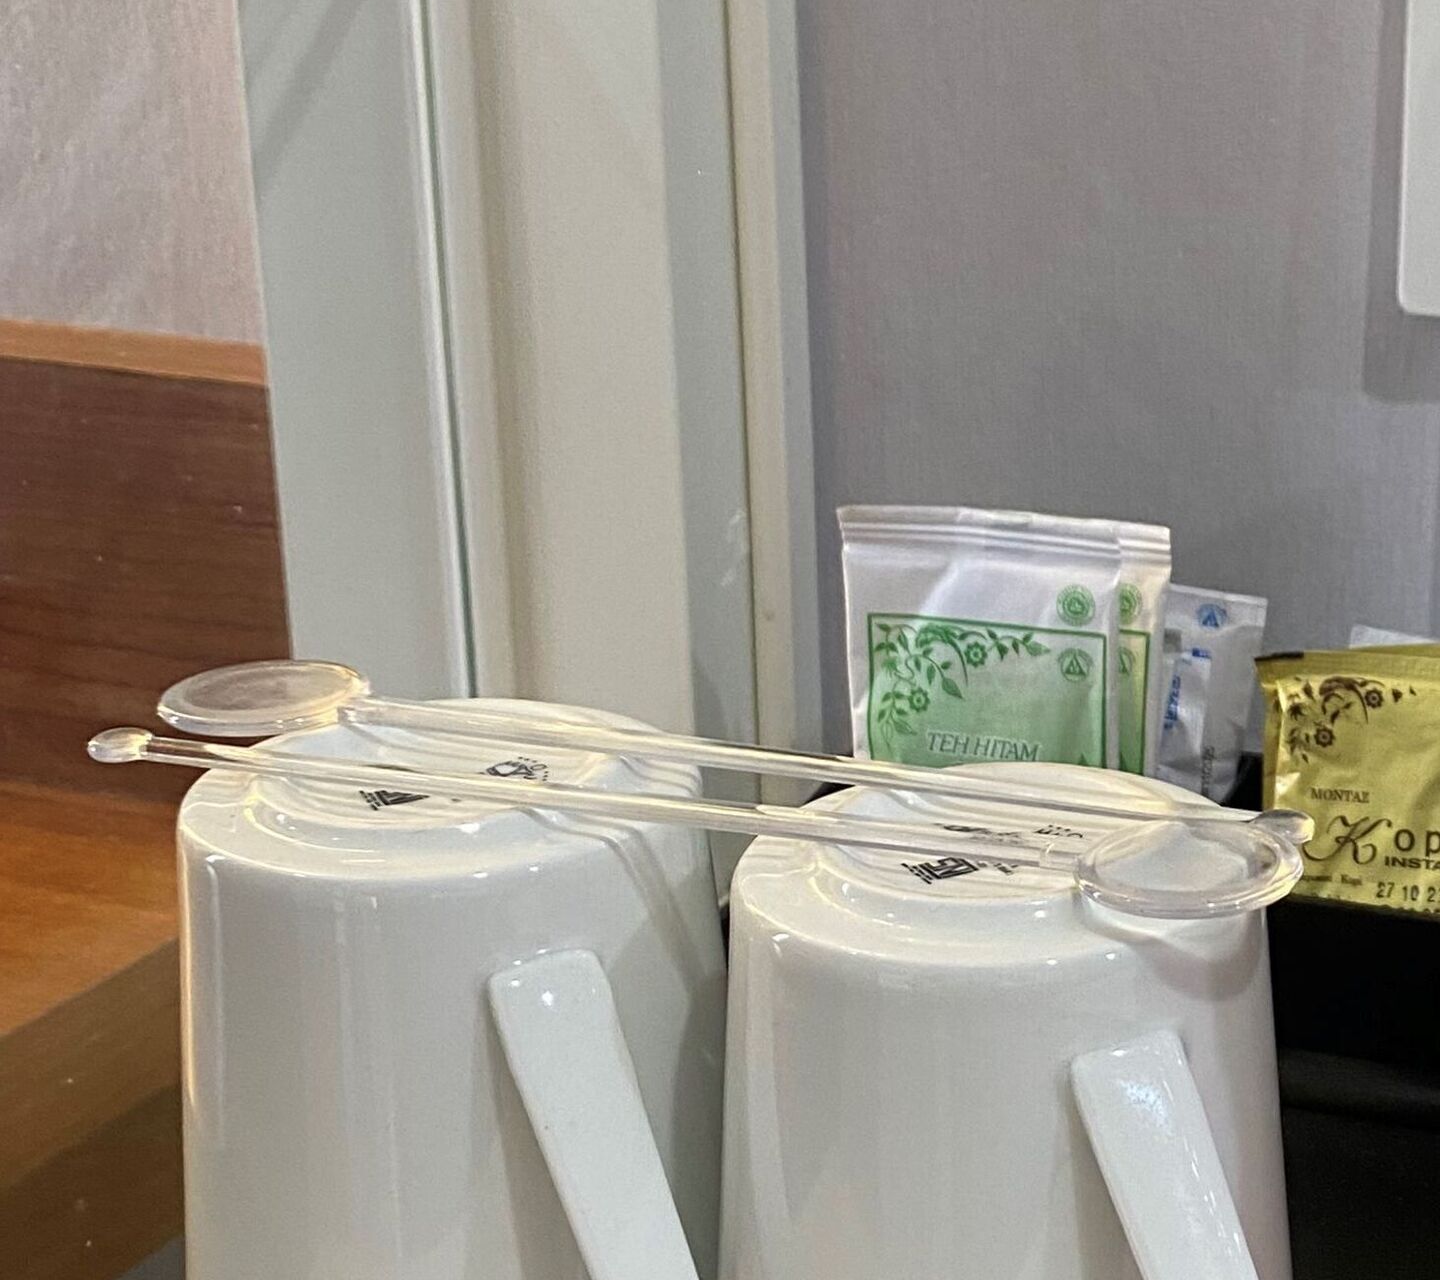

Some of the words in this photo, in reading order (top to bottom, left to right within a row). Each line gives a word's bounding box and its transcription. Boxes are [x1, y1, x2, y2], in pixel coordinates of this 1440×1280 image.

[928, 731, 969, 754] TEH
[972, 734, 1039, 761] HITAM
[1375, 880, 1395, 899] 27
